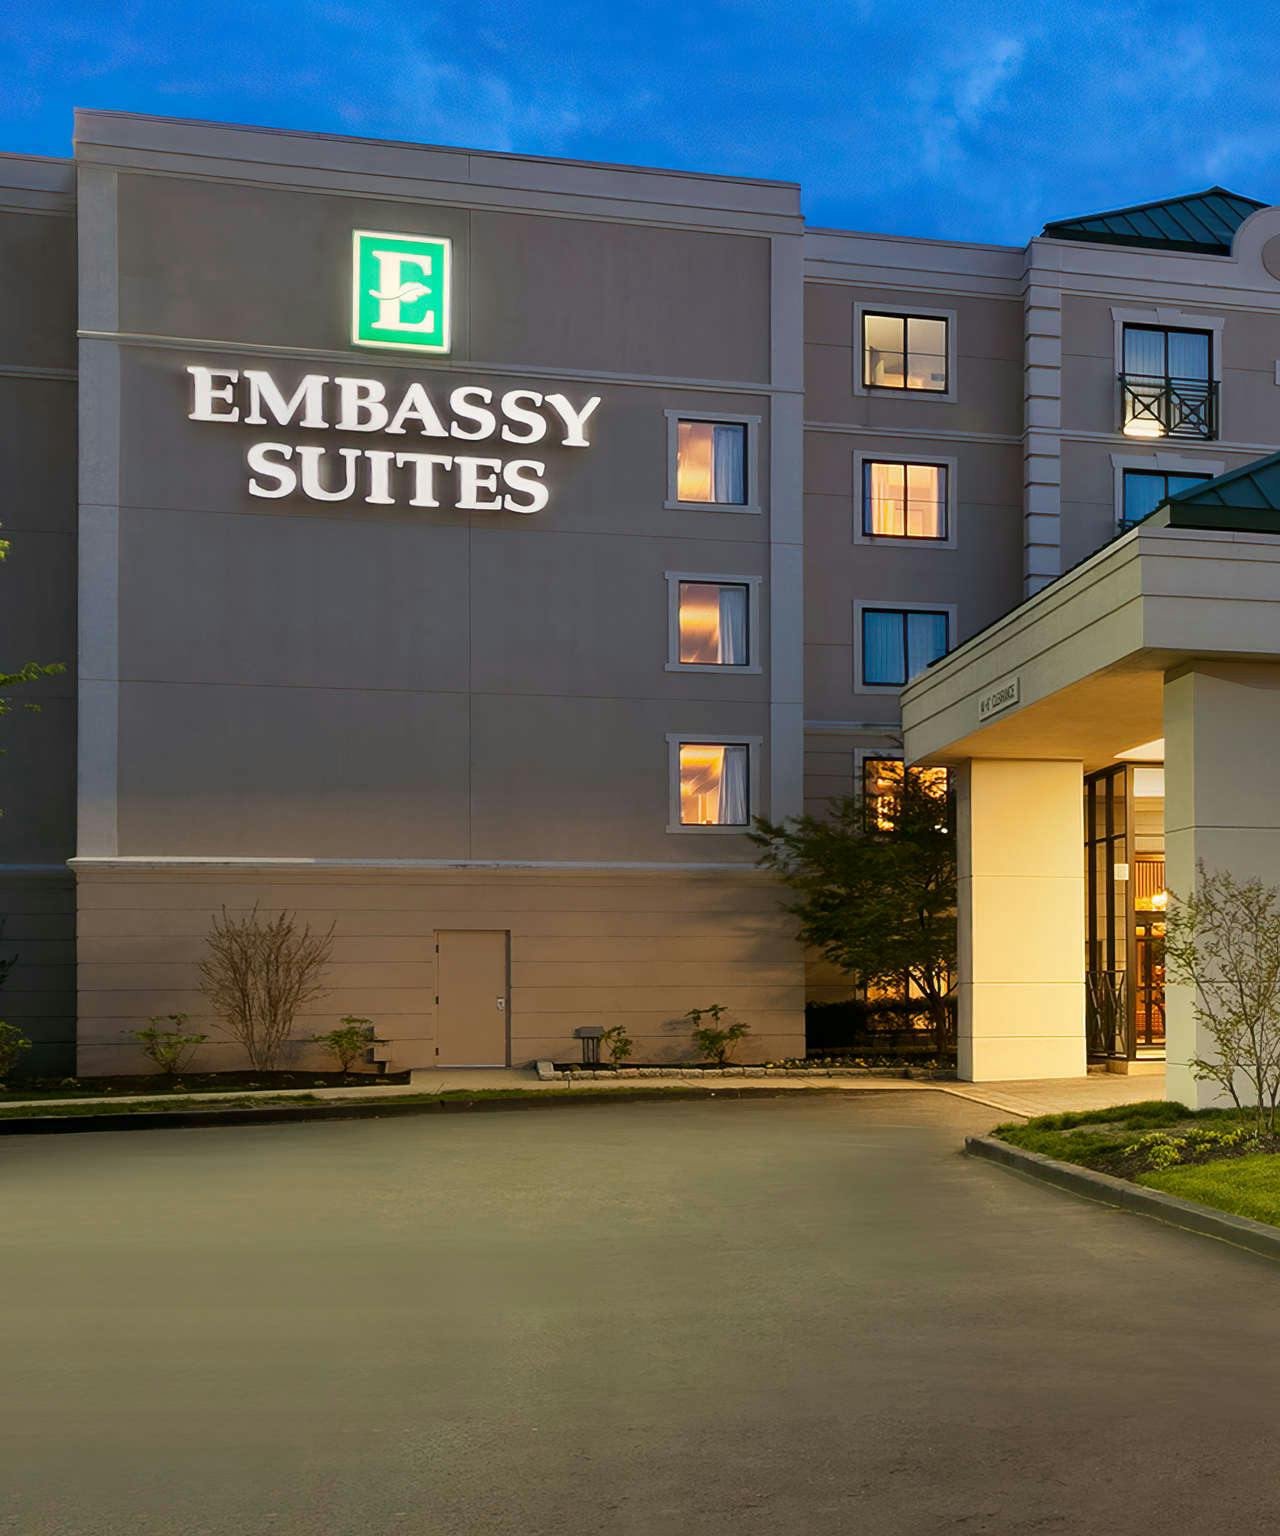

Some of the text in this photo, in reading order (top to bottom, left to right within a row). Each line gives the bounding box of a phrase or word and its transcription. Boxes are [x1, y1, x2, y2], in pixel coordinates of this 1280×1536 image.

[369, 250, 435, 334] E
[186, 366, 601, 448] EMBASSY
[246, 442, 549, 514] SUITES
